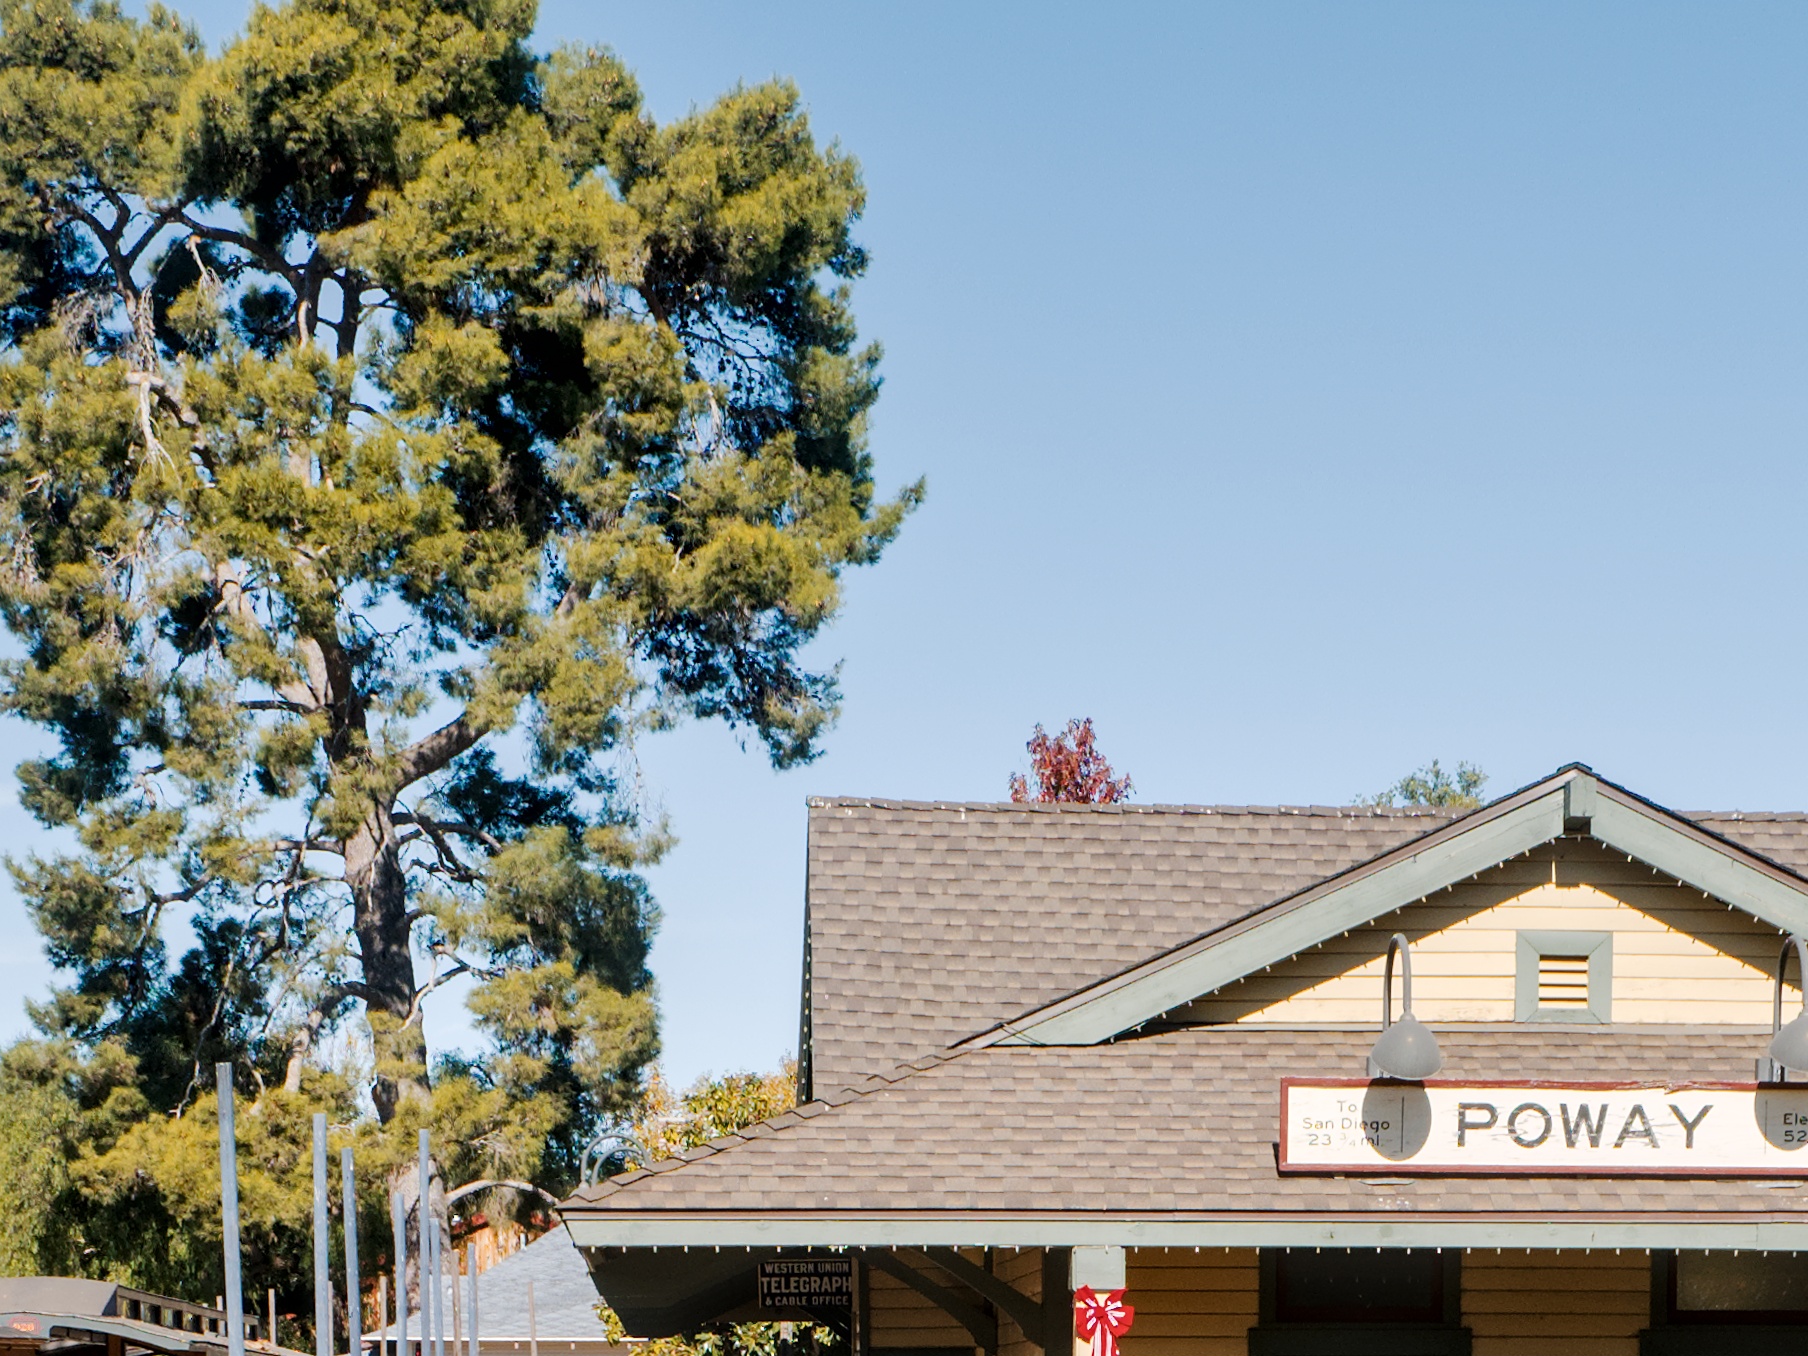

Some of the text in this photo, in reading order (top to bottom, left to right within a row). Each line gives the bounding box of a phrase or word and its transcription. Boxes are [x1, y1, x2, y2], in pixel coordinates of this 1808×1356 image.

[1337, 1100, 1358, 1113] To
[1302, 1117, 1391, 1134] San Diego
[1457, 1102, 1714, 1150] POWAY
[1308, 1133, 1332, 1146] 23
[764, 1261, 850, 1275] WESTERN UNION
[761, 1275, 853, 1295] TELEGRAPH
[775, 1295, 808, 1306] CABLE
[812, 1295, 849, 1306] OFFICE
